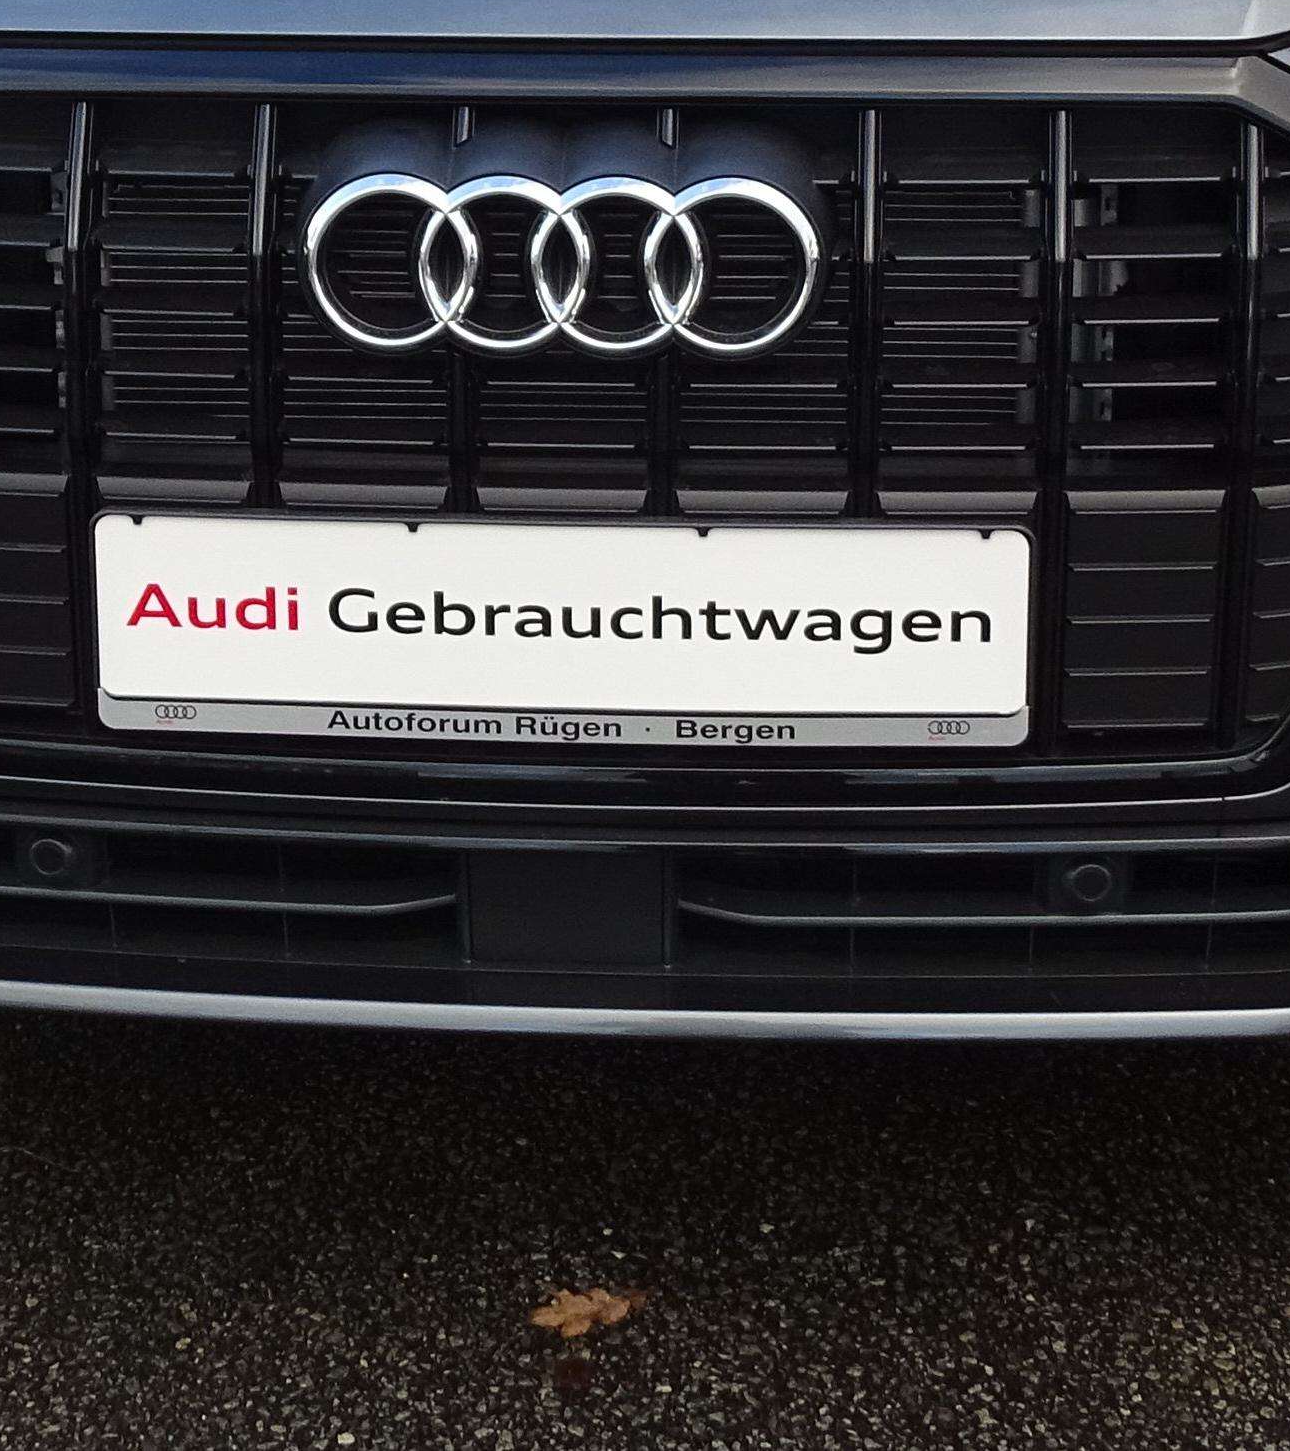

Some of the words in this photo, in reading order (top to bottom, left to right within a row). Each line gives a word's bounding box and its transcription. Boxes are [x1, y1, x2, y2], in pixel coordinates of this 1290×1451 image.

[127, 583, 299, 631] Audi
[328, 587, 991, 654] Gebrauchtwagen
[328, 710, 502, 734] Autoforum
[515, 716, 622, 741] Rügen
[675, 719, 796, 743] Bergen
